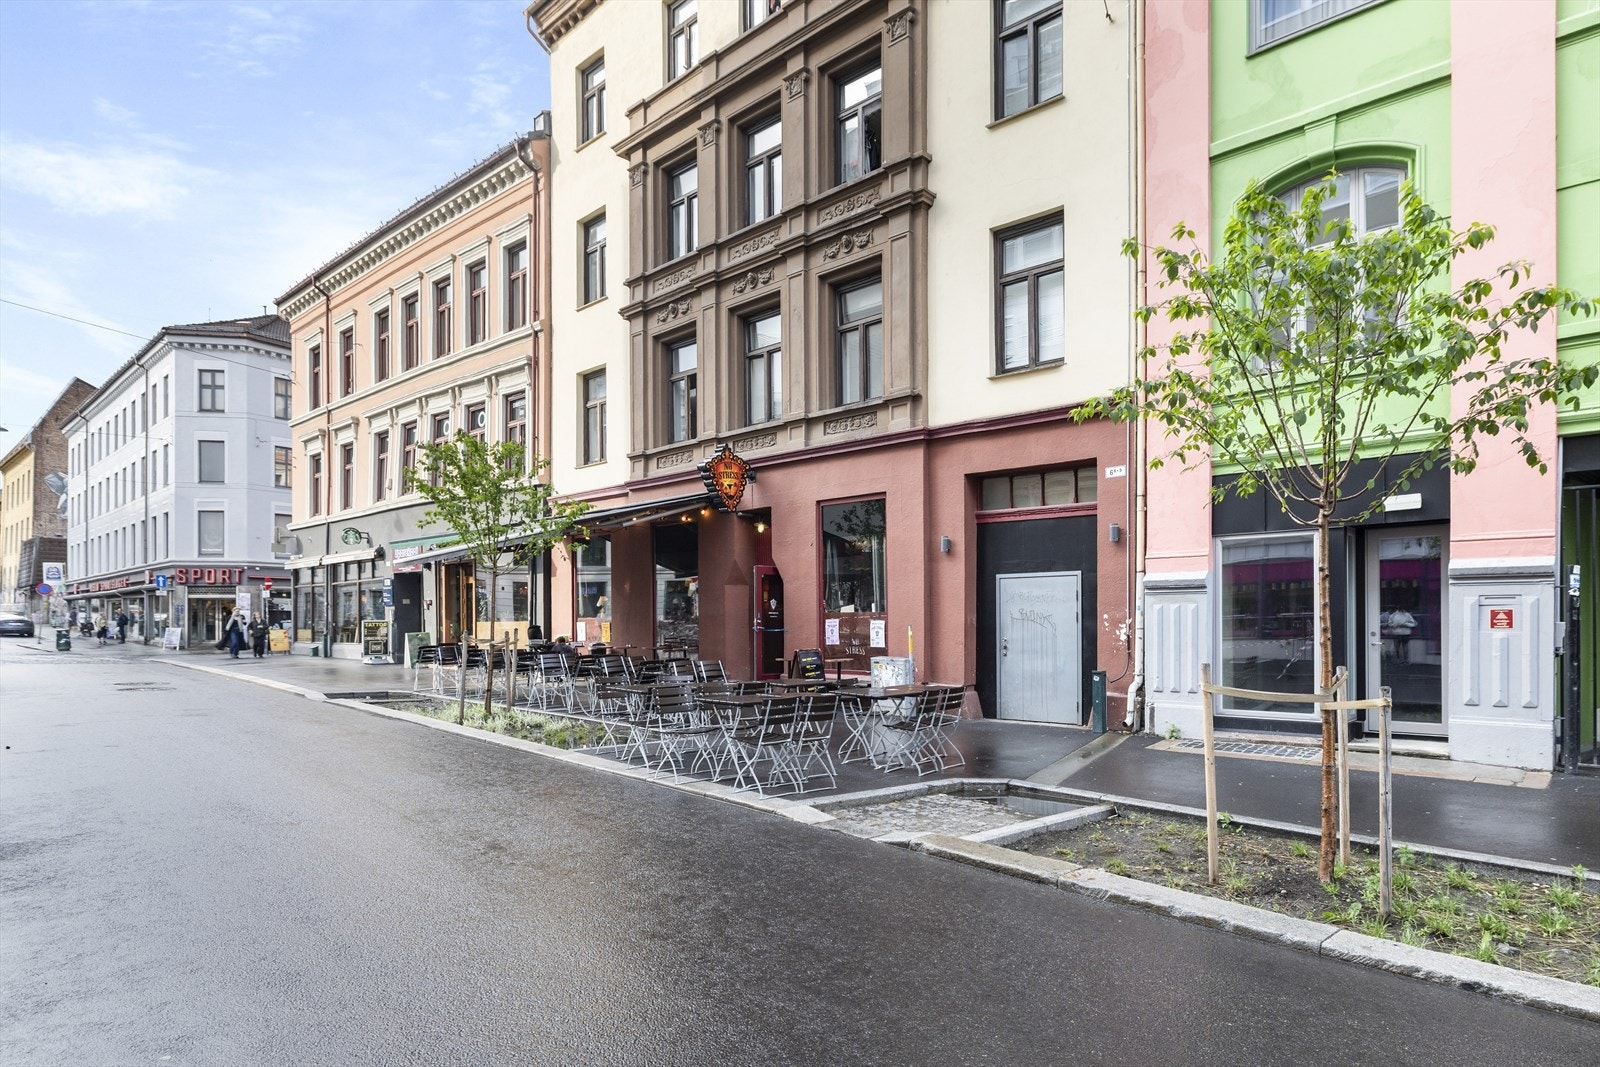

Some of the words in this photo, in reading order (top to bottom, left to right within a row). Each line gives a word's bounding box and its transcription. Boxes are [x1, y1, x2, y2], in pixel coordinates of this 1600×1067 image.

[724, 463, 733, 471] NO
[718, 471, 738, 479] STRESS
[176, 568, 245, 585] SPORT
[845, 646, 866, 656] STRESS
